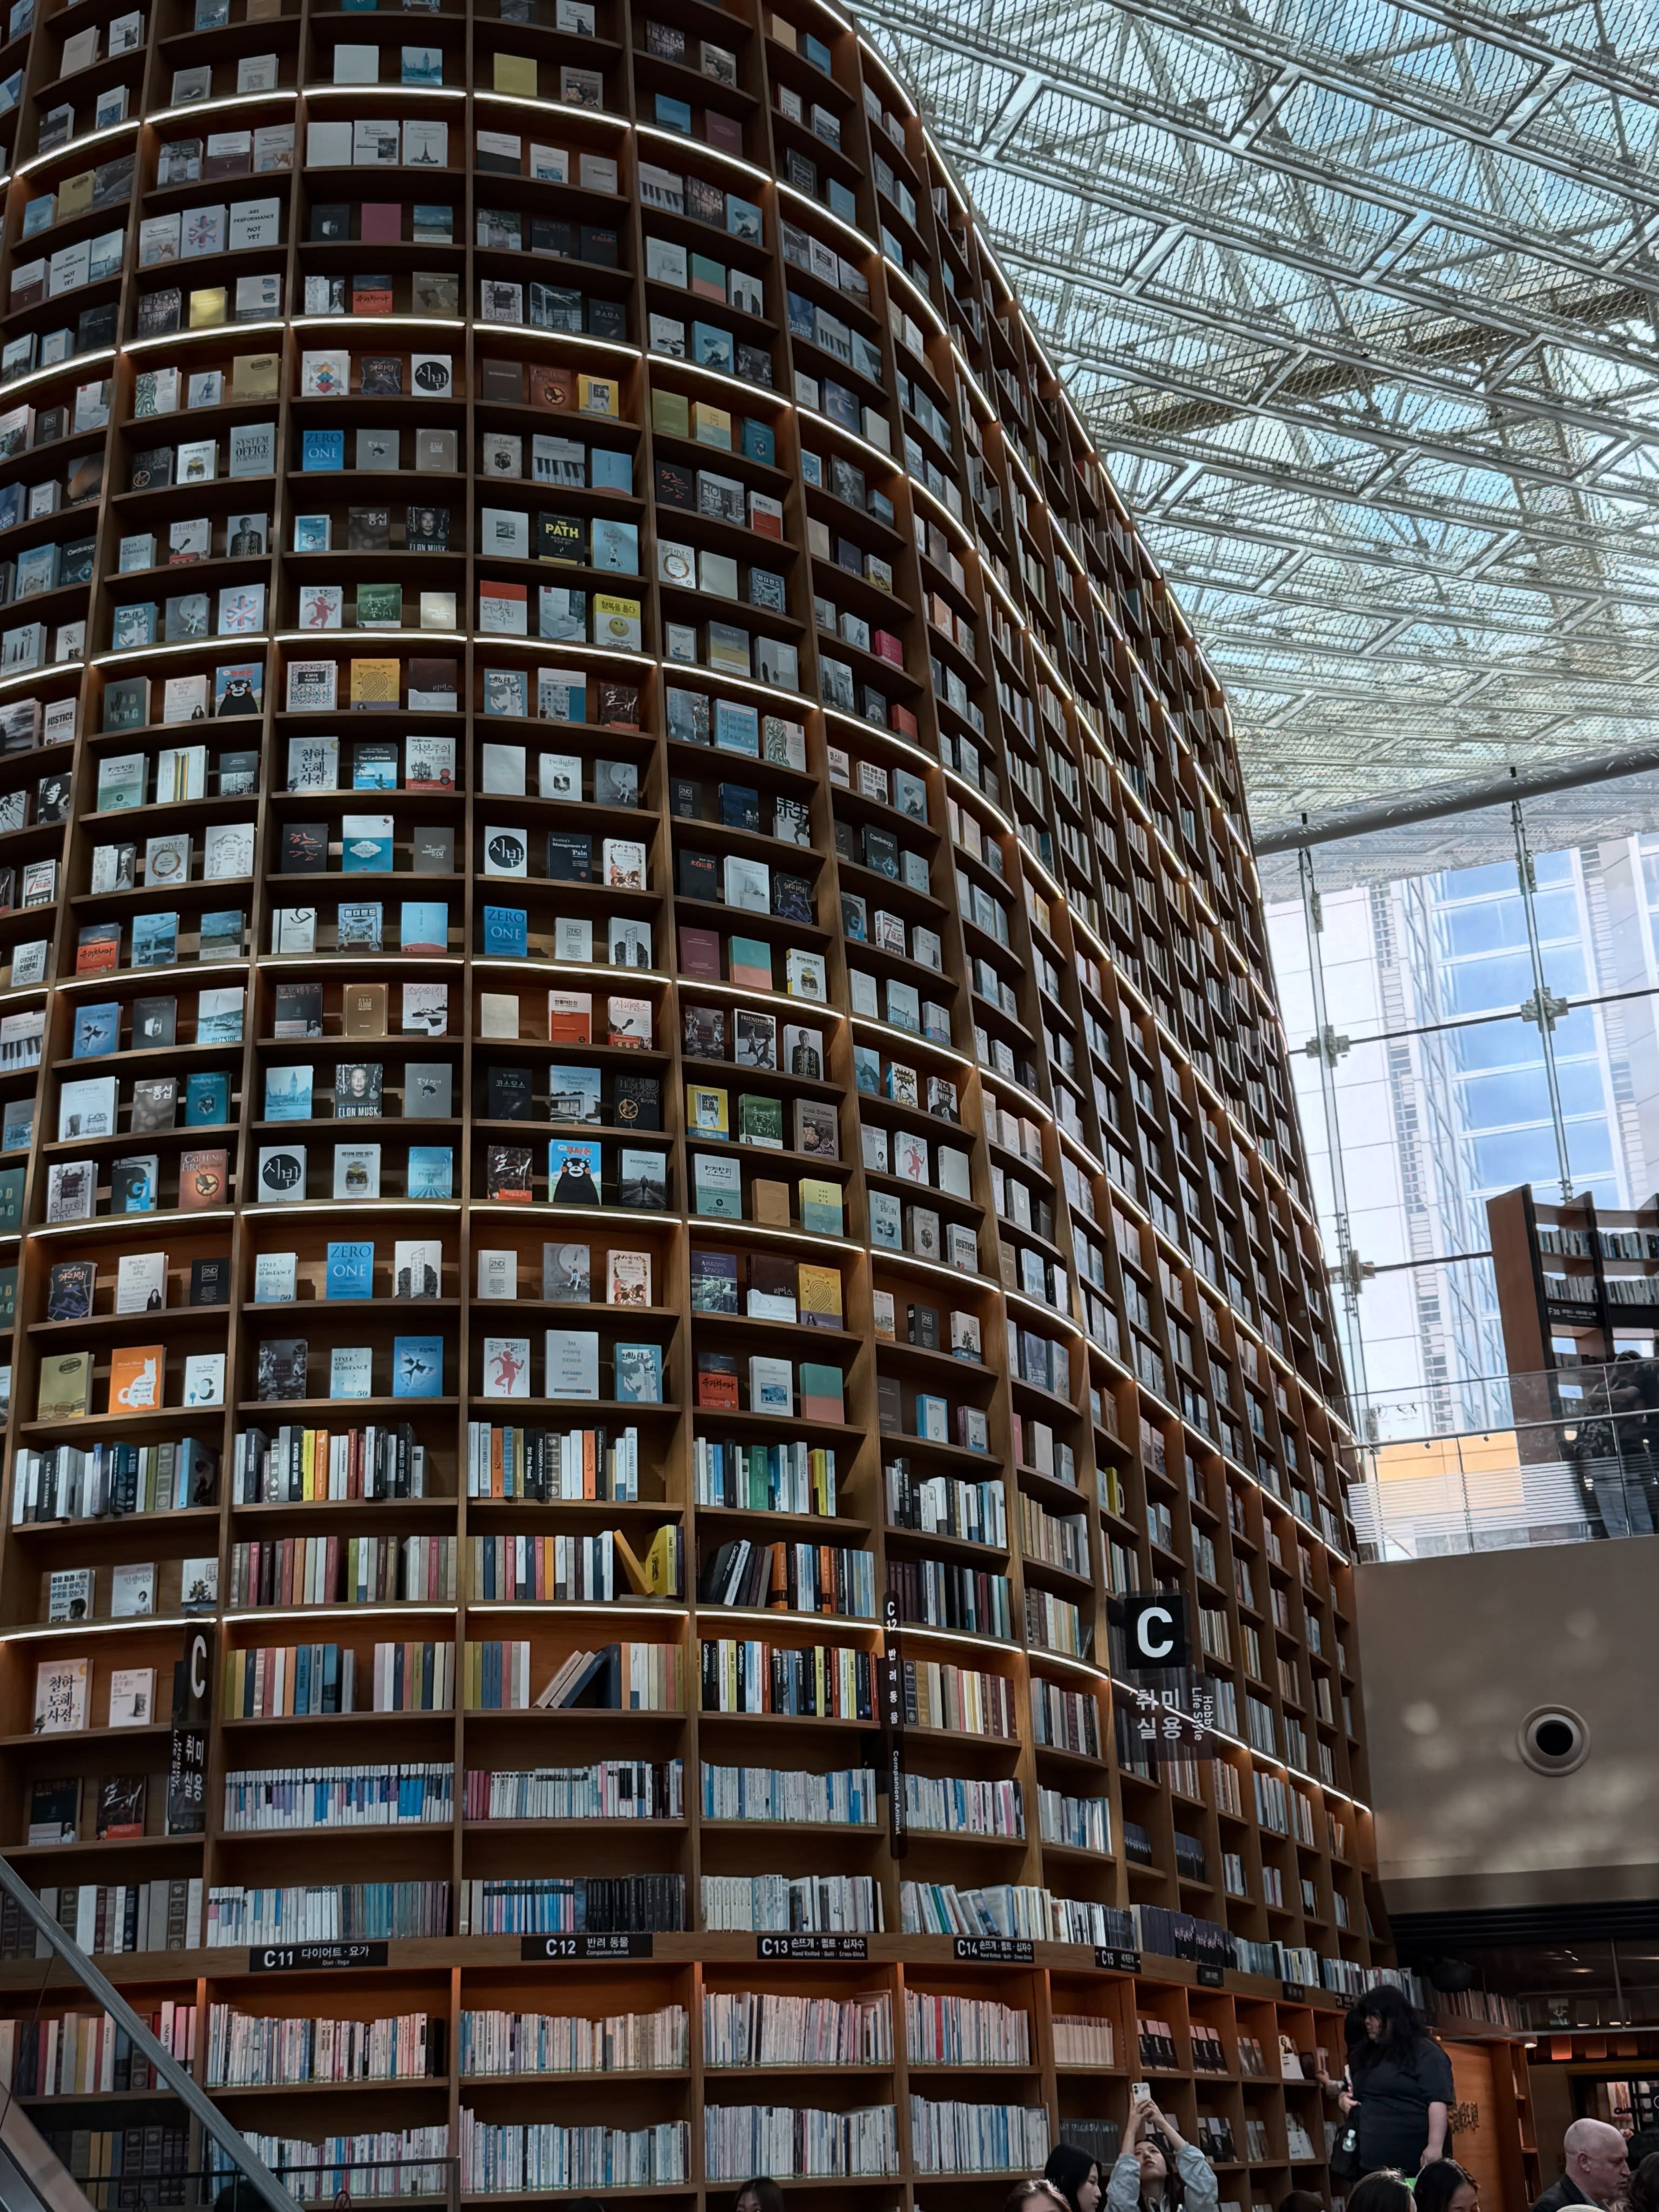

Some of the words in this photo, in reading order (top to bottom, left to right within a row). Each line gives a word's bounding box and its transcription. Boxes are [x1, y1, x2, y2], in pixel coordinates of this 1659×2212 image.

[415, 364, 447, 390] 시밤
[306, 431, 342, 443] ZERO
[235, 443, 269, 456] OFFICE
[308, 447, 338, 457] ONE
[367, 512, 387, 527] 통섭
[545, 523, 579, 538] PATH
[48, 712, 73, 726] JUSTICE
[548, 758, 575, 767] twilight
[489, 838, 524, 868] 시밤
[487, 908, 525, 922] ZERO
[491, 926, 522, 941] ONE
[495, 1080, 526, 1088] 코스모스
[153, 1084, 172, 1101] 통섭
[338, 1106, 356, 1117] ELON
[358, 1105, 379, 1117] MUSK
[262, 1157, 299, 1187] 시밤
[330, 1245, 371, 1258] ZERO
[332, 1264, 367, 1278] ONE
[702, 1260, 727, 1269] AMAZING
[494, 1461, 501, 1469] 75
[586, 1464, 594, 1472] 75
[726, 1545, 739, 1572] Cardiology
[887, 1601, 895, 1616] C
[886, 1618, 897, 1632] 12
[1137, 1606, 1174, 1658] C
[191, 1634, 207, 1699] C
[49, 1674, 77, 1692] 철학
[47, 1692, 73, 1708] 도해
[1136, 1688, 1180, 1711] 취미
[1191, 1687, 1203, 1709] Life
[47, 1707, 72, 1724] 사전
[1203, 1695, 1215, 1731] Hobby
[1137, 1716, 1182, 1741] 실용
[1192, 1710, 1204, 1742] Style
[185, 1734, 205, 1768] 취미
[893, 1750, 901, 1803] Companion
[184, 1771, 203, 1802] 실용
[545, 1938, 577, 1957] C12
[586, 1937, 606, 1948] 반려
[610, 1937, 629, 1948] 동물
[761, 1938, 788, 1957] C13
[791, 1938, 815, 1949] 손뜨개
[842, 1938, 865, 1950] 십자수
[957, 1939, 978, 1956] C14
[264, 1950, 294, 1967] C11
[301, 1947, 343, 1960] 다이어트
[349, 1946, 369, 1958] 요가
[1101, 1950, 1115, 1966] C15
